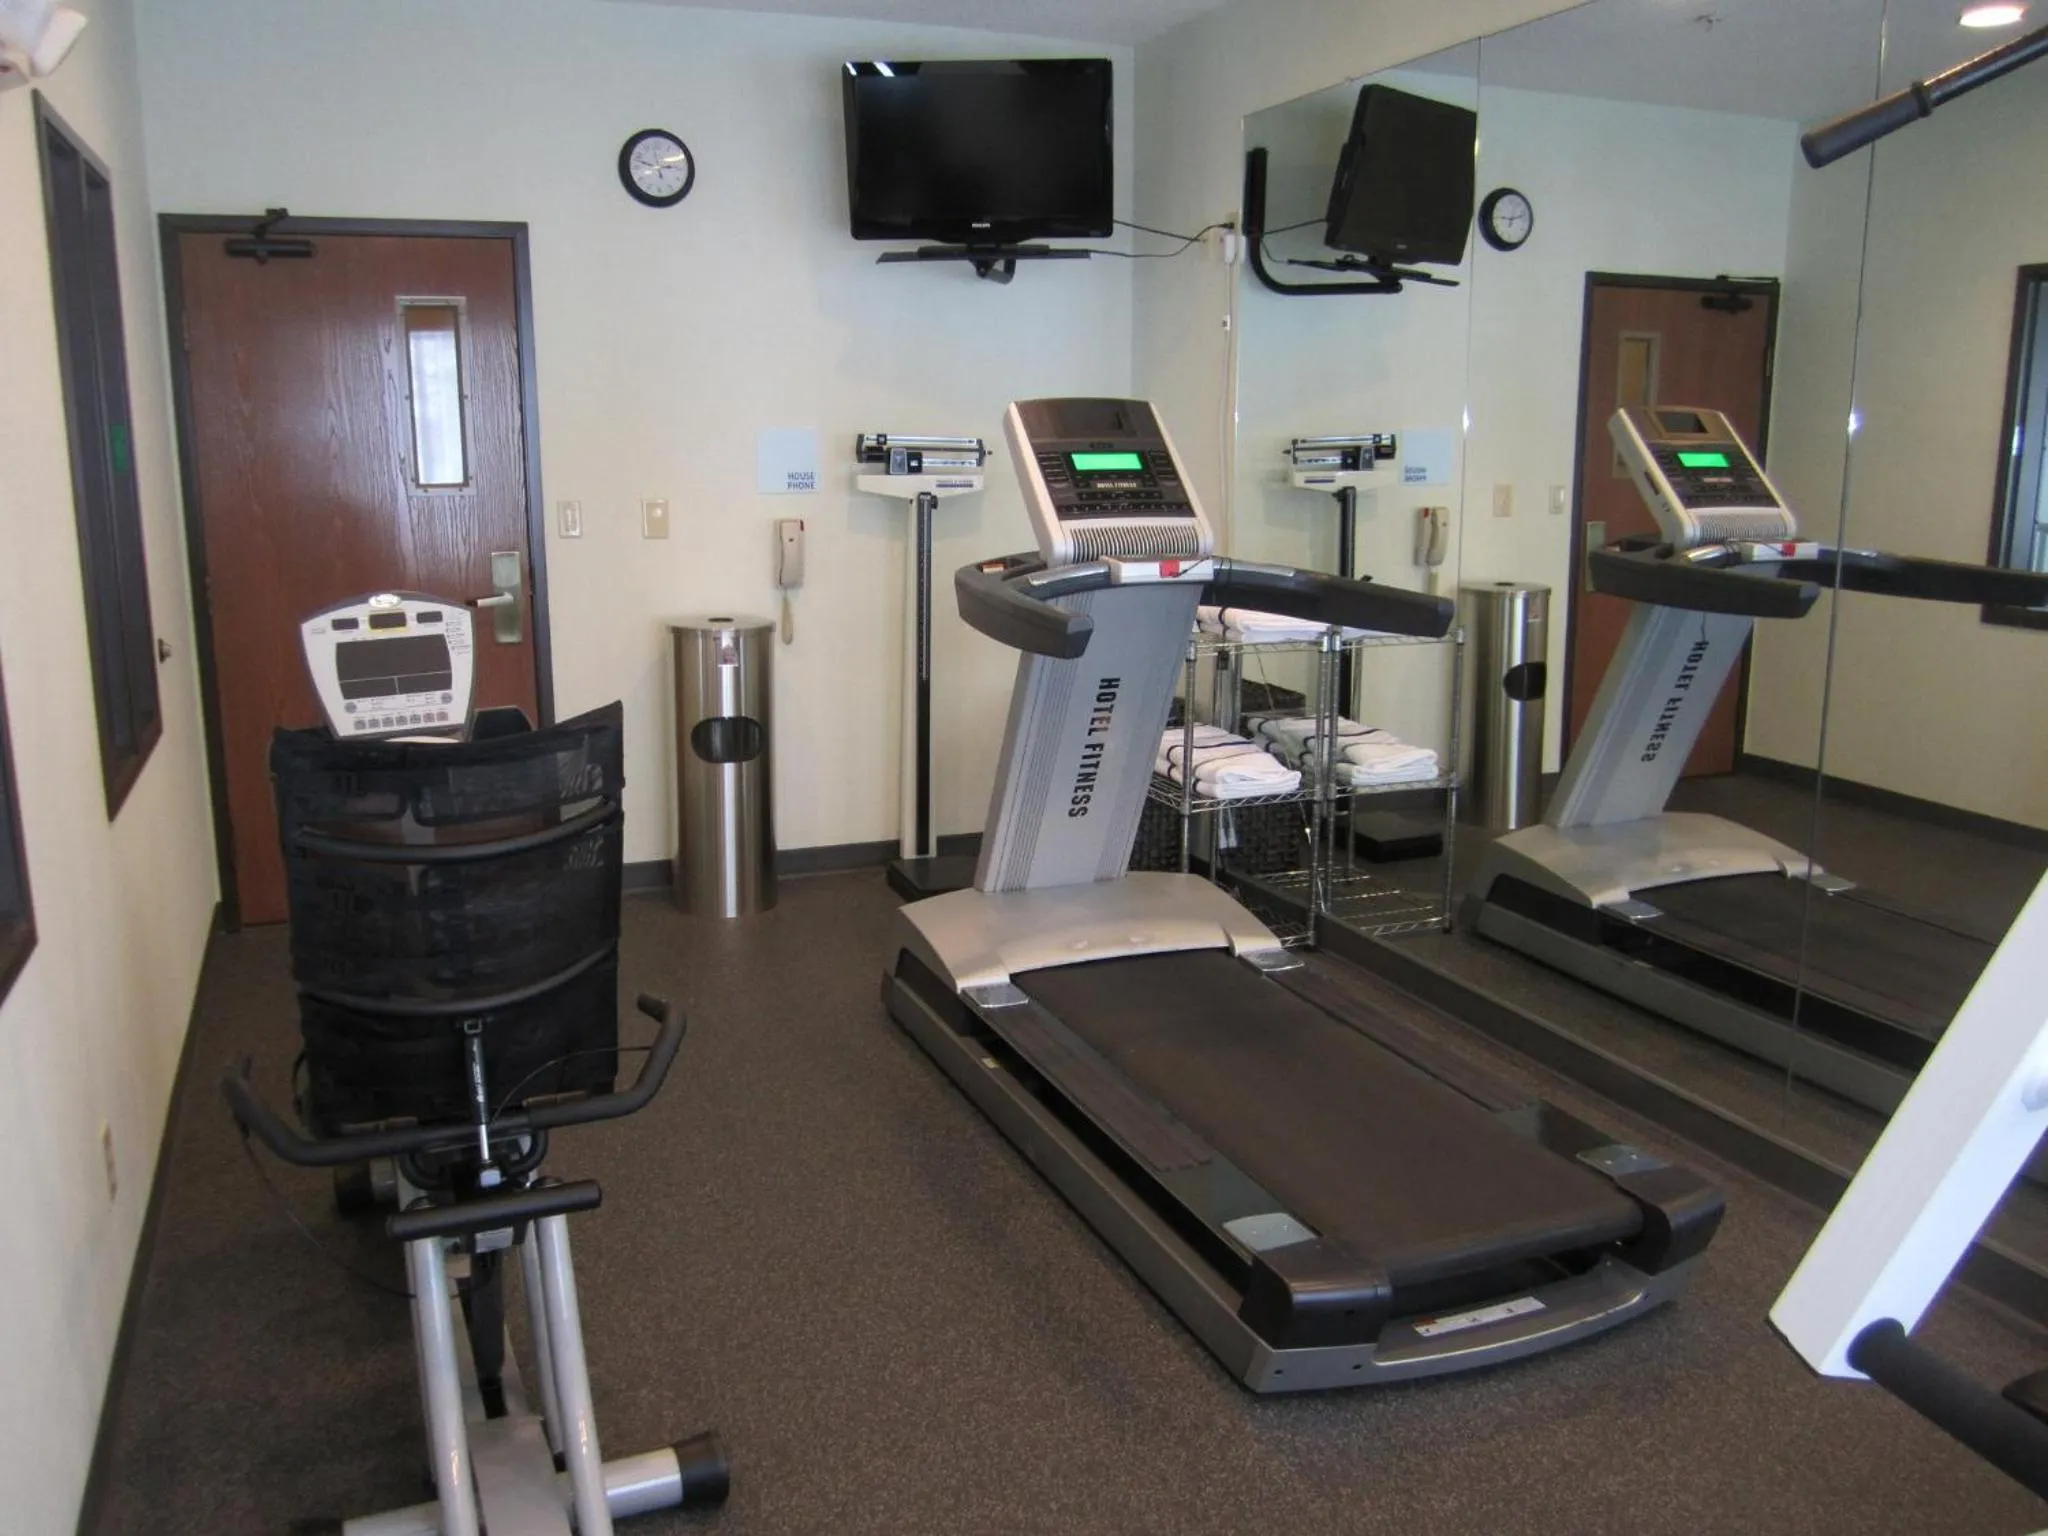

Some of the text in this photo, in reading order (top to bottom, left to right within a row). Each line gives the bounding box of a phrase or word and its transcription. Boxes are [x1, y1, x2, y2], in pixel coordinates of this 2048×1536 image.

[787, 471, 816, 480] HOUSE
[787, 481, 816, 490] PHONE
[1068, 677, 1121, 818] HOTEL FITNESS
